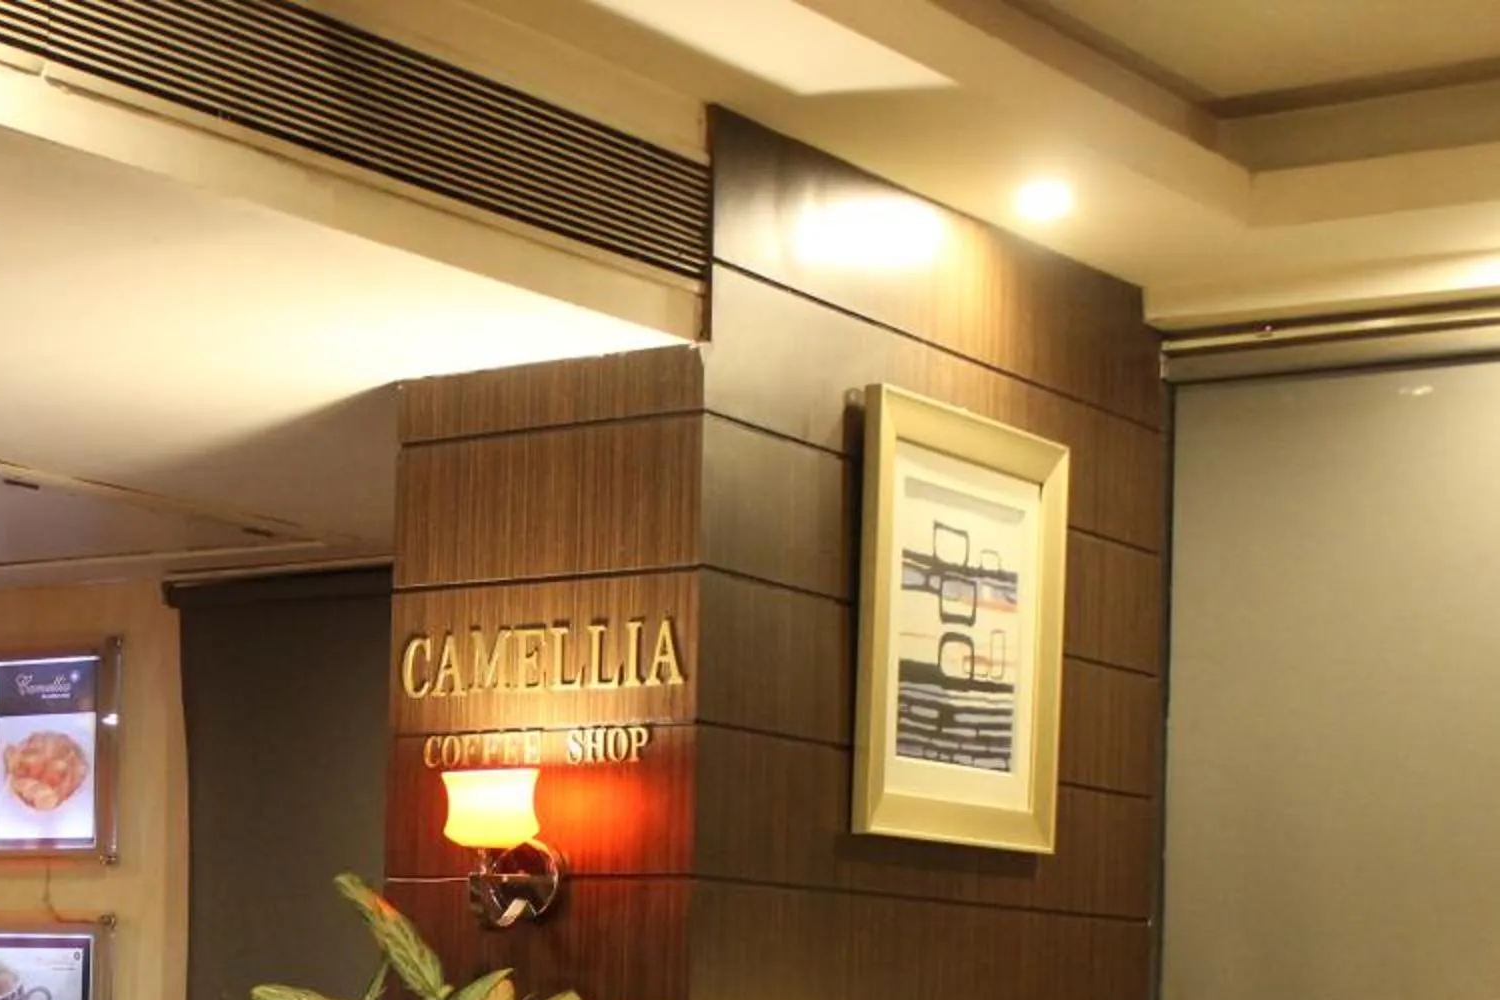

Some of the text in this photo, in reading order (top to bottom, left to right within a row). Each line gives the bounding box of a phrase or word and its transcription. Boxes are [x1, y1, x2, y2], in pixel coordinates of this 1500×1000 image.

[403, 618, 684, 699] CAMELLIA
[423, 726, 649, 768] COFFEE SHOP
